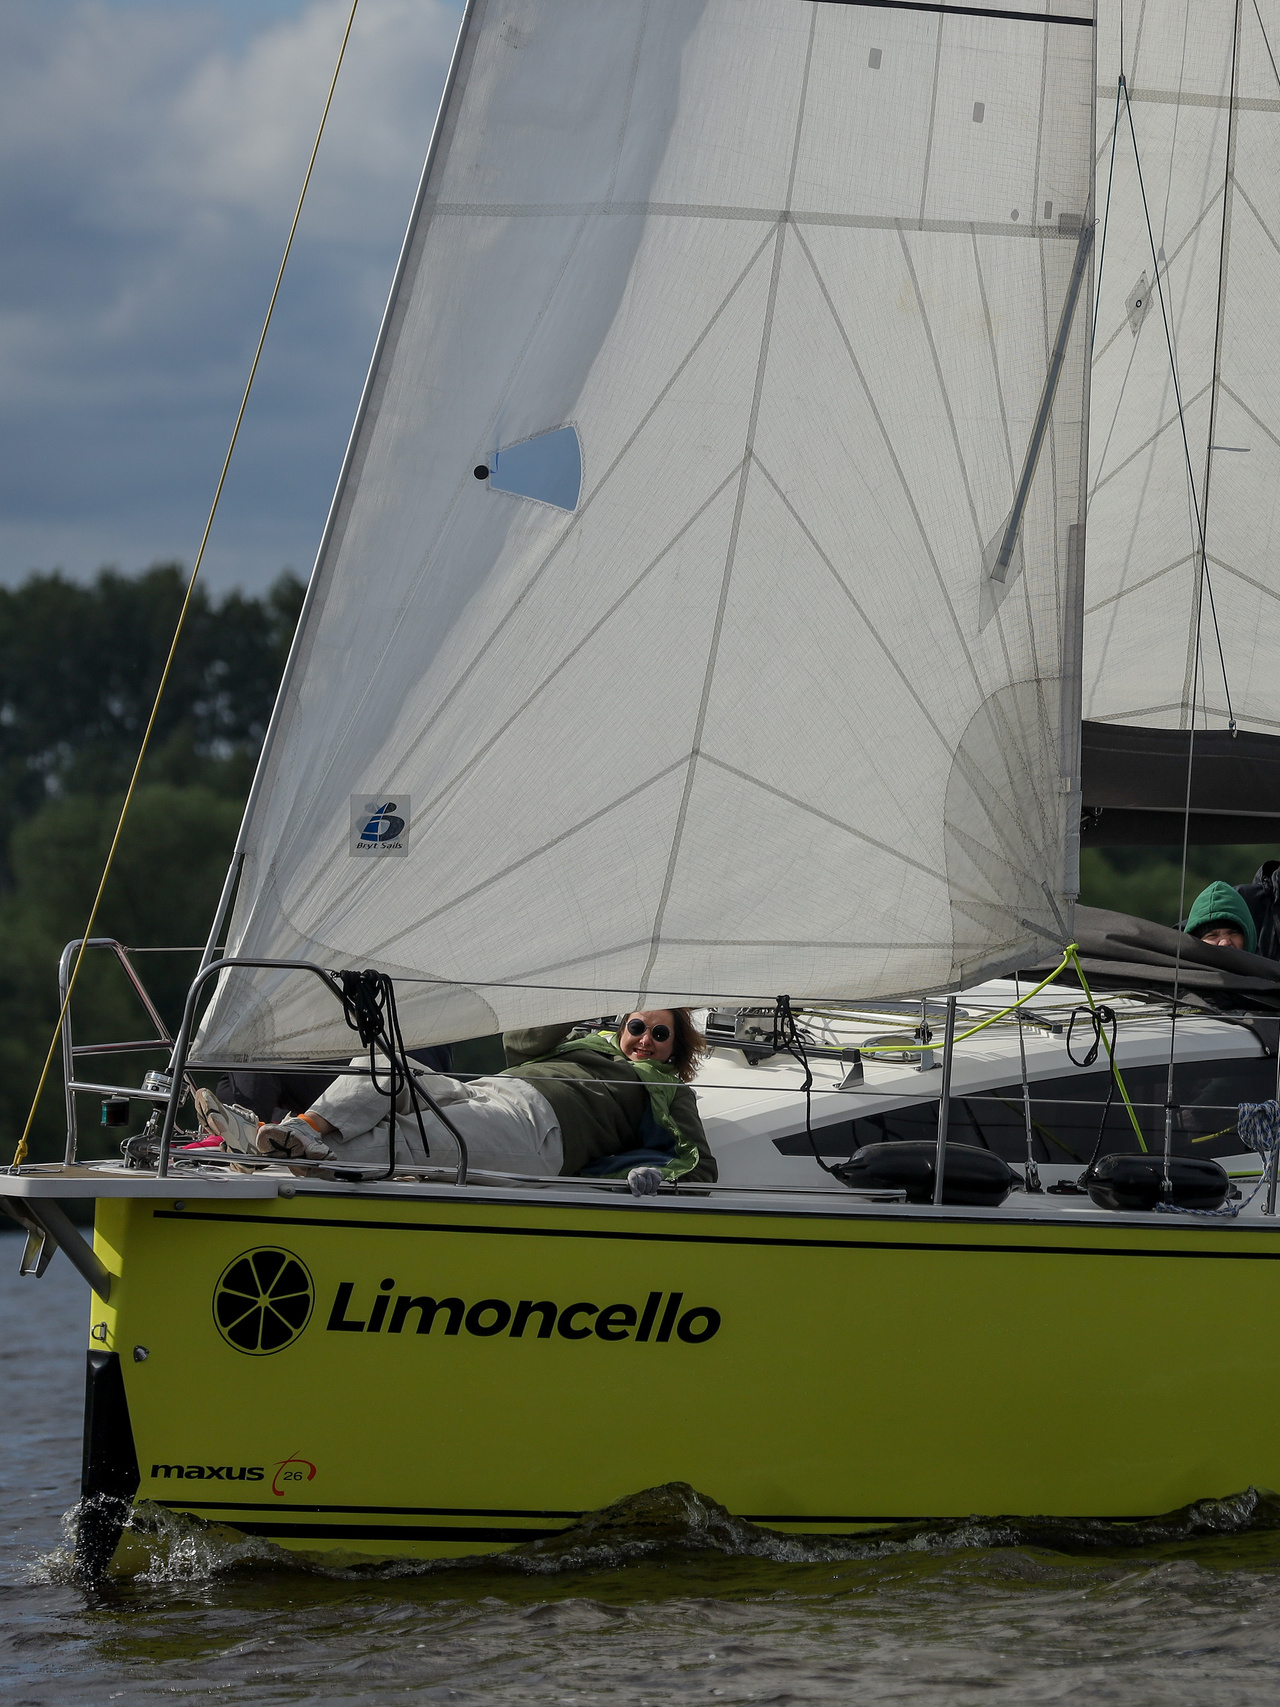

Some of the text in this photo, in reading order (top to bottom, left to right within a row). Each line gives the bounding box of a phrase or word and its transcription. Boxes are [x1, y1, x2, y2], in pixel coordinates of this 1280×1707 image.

[356, 842, 378, 850] Bryt
[326, 1277, 721, 1344] Limoncello
[150, 1464, 303, 1481] maxus 26
